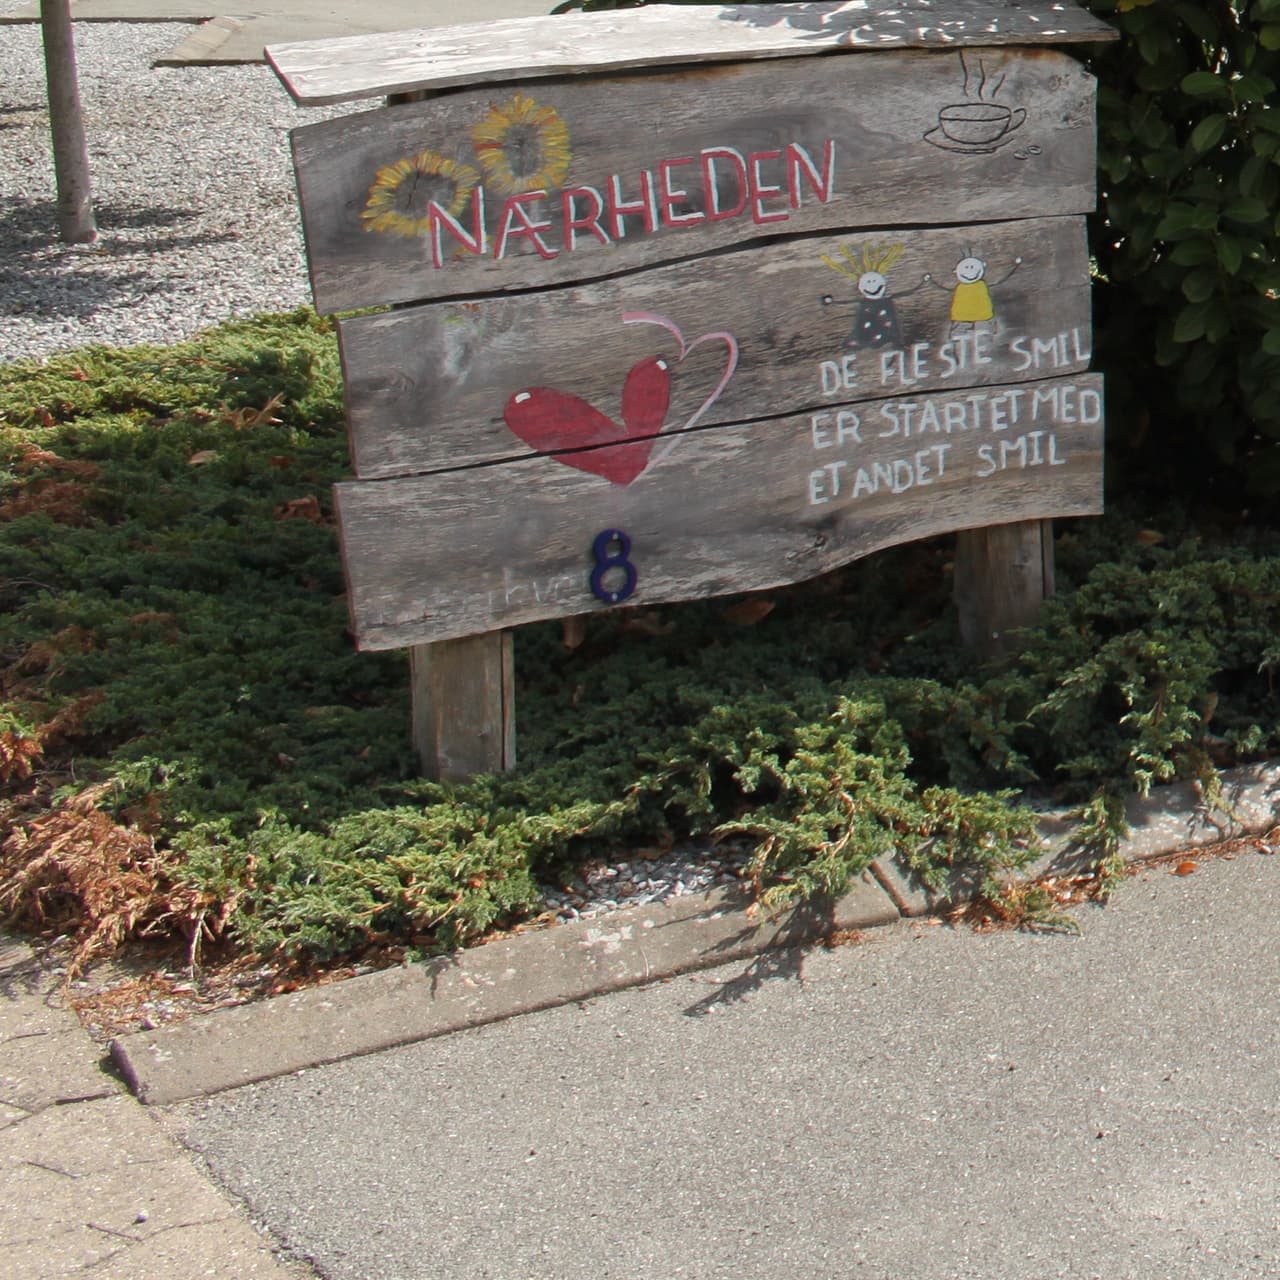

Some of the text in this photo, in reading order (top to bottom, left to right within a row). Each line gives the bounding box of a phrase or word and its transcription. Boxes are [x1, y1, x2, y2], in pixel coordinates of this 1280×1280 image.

[428, 138, 835, 269] NÆRHEDEN
[819, 327, 1092, 396] DE FLESTE SMIL
[811, 385, 1101, 449] ER STARTET MED
[809, 430, 1067, 505] ET ANDET SMIL
[590, 528, 638, 603] 8
